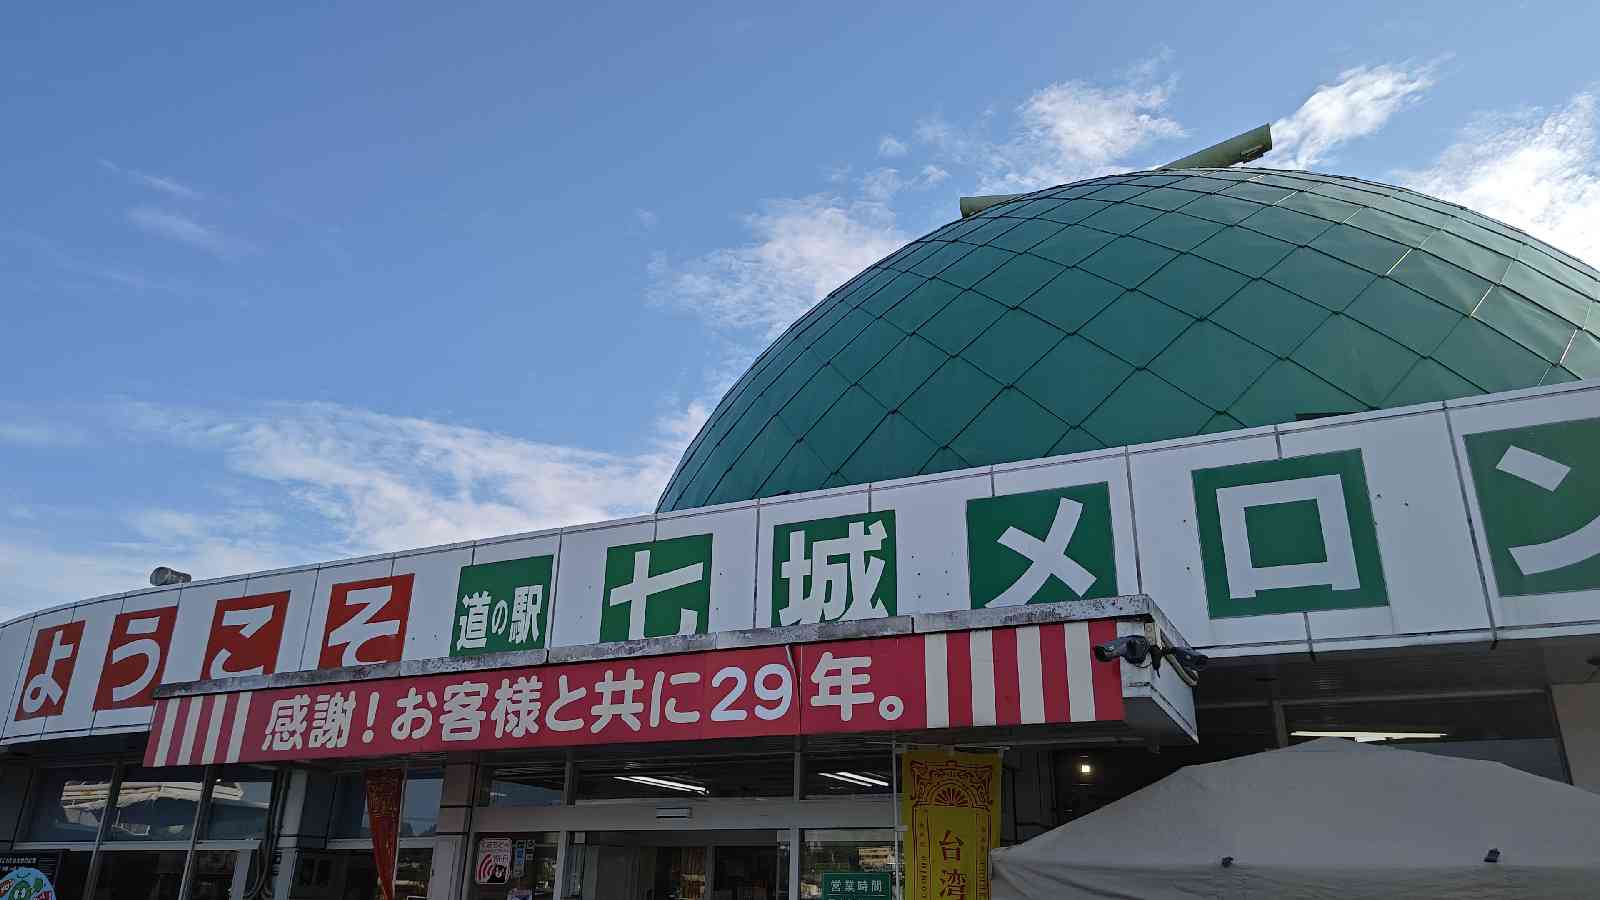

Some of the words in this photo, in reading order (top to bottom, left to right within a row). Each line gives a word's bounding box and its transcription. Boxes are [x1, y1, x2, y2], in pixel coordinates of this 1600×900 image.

[23, 585, 401, 713] ようこそ
[457, 584, 543, 651] 道の駅
[831, 879, 882, 893] 営業時間
[939, 829, 969, 900] 台湾
